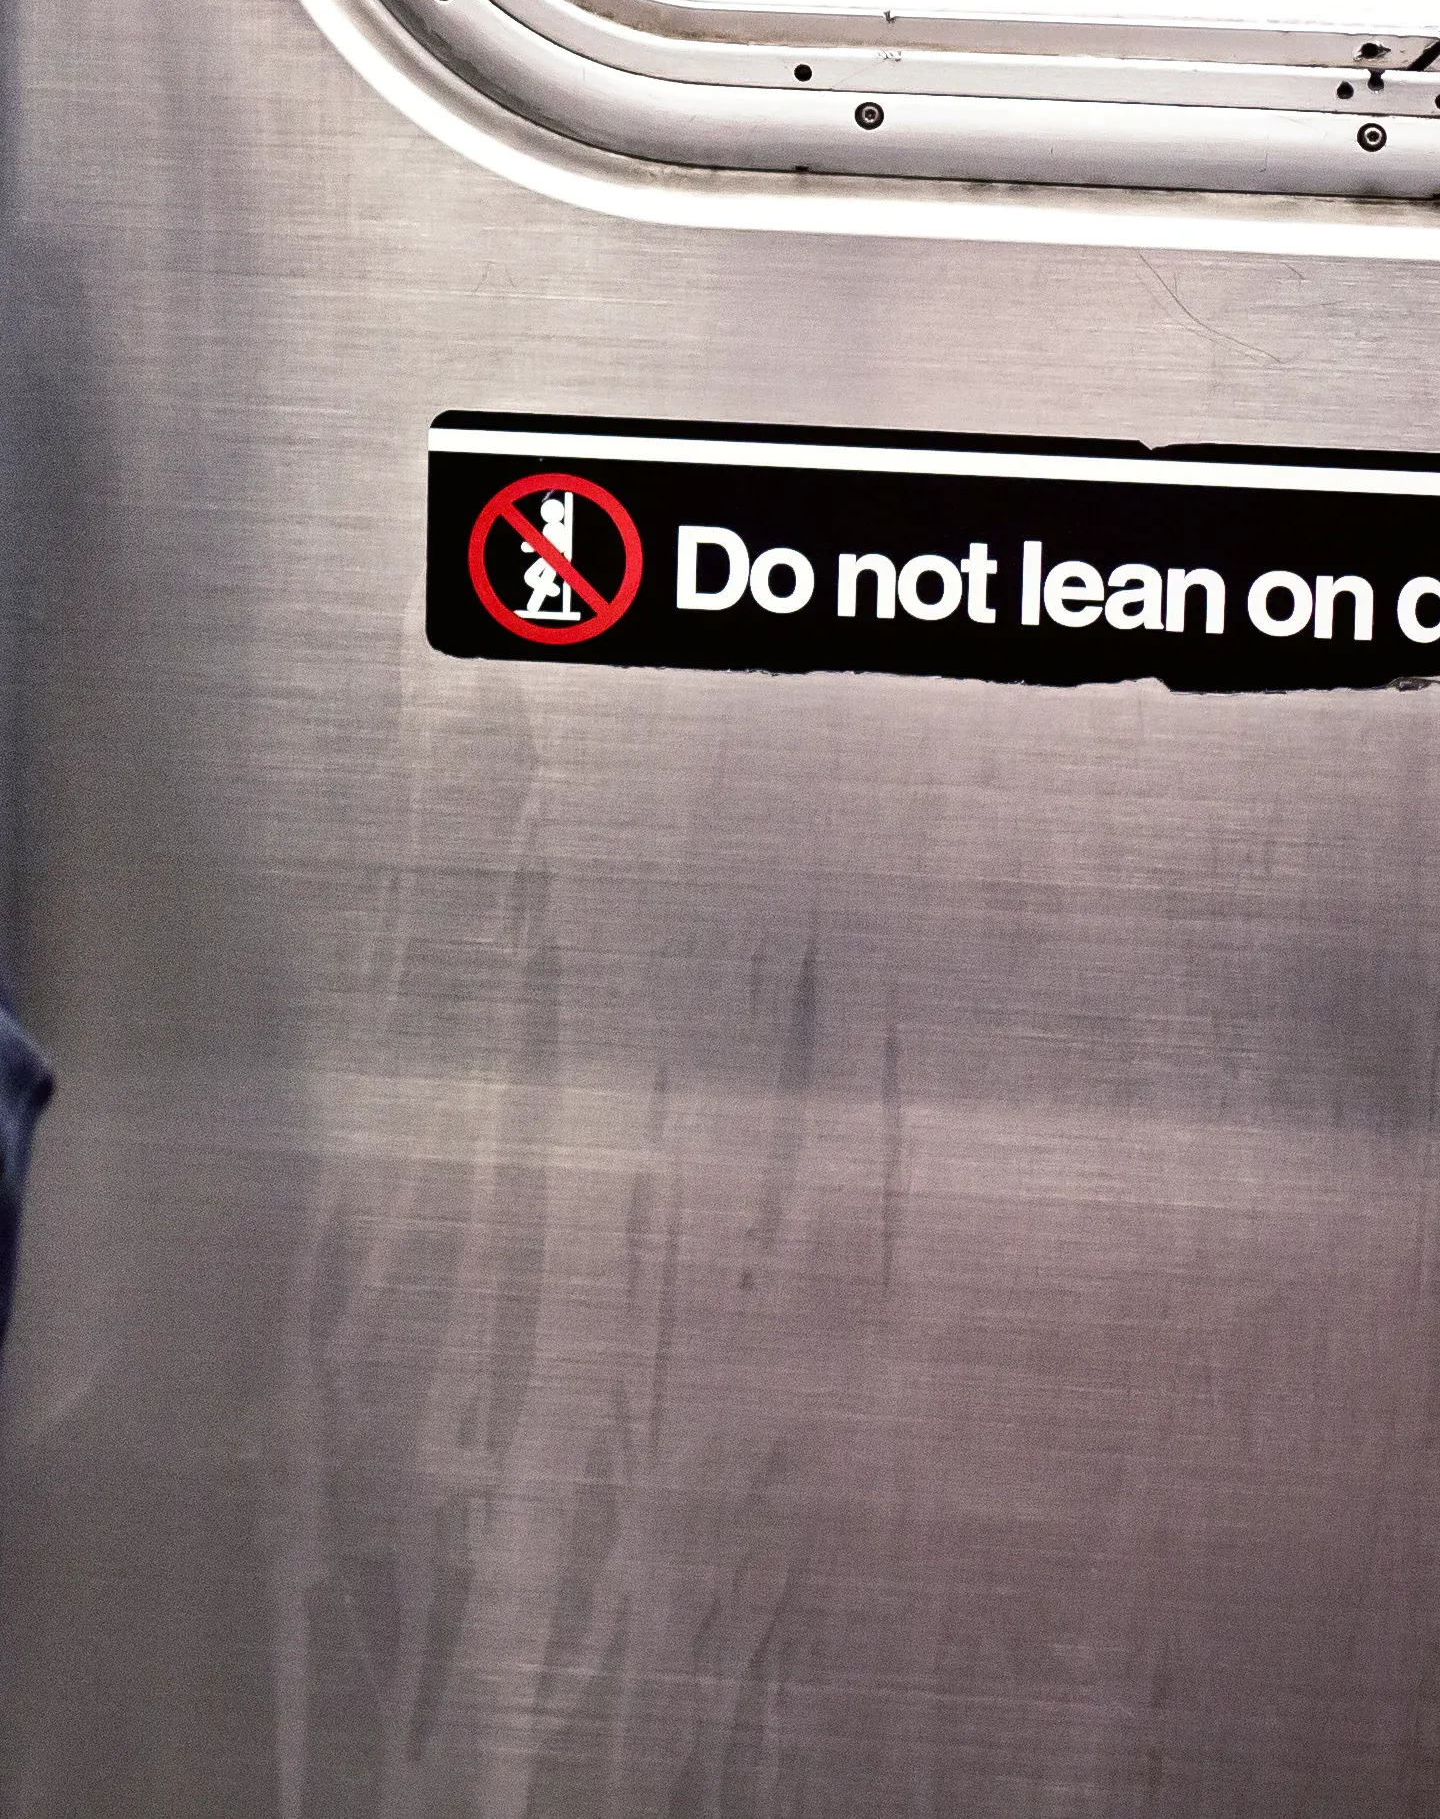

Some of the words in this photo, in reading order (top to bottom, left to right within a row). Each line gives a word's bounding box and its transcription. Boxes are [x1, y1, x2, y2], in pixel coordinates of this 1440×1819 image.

[675, 524, 816, 614] Do
[836, 542, 998, 624] not
[1021, 540, 1226, 635] lean
[1246, 569, 1374, 642] on
